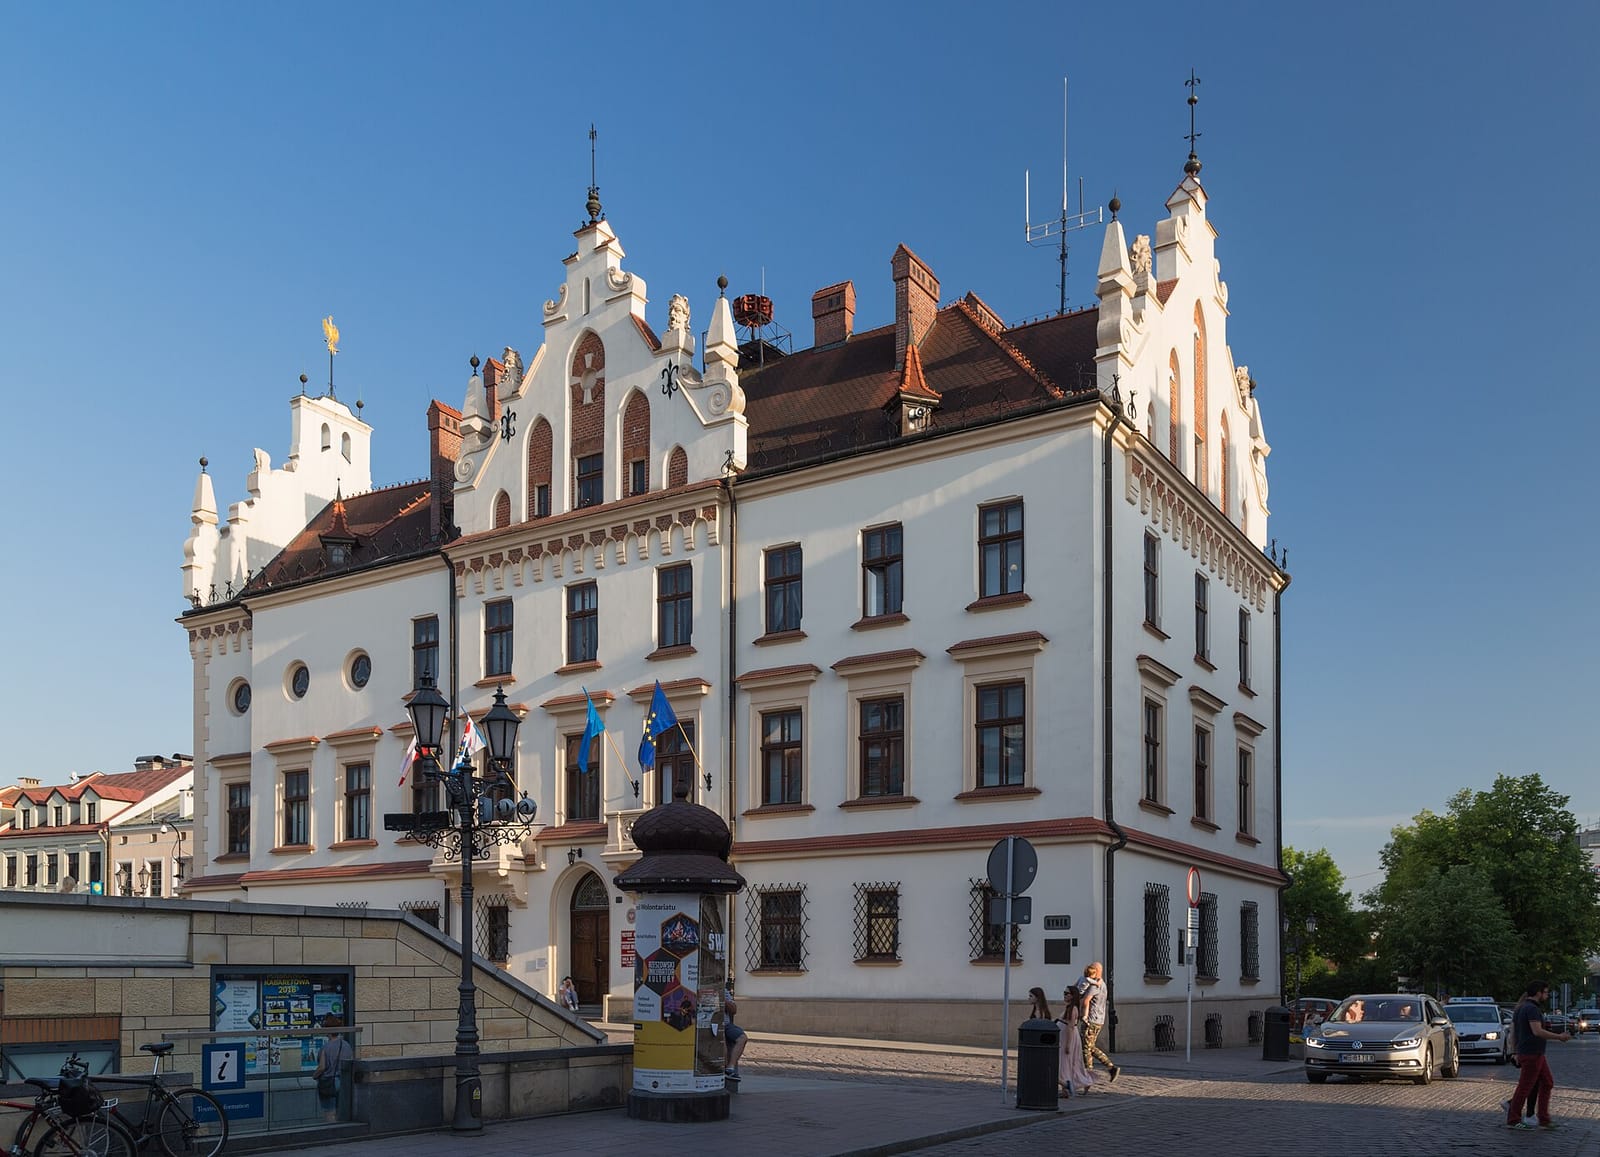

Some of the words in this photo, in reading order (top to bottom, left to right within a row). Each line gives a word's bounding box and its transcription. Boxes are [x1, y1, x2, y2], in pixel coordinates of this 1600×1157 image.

[1047, 918, 1068, 927] RYNEK
[264, 978, 310, 986] KABARETOWA
[648, 975, 675, 983] KULTURY
[278, 986, 297, 994] 2018
